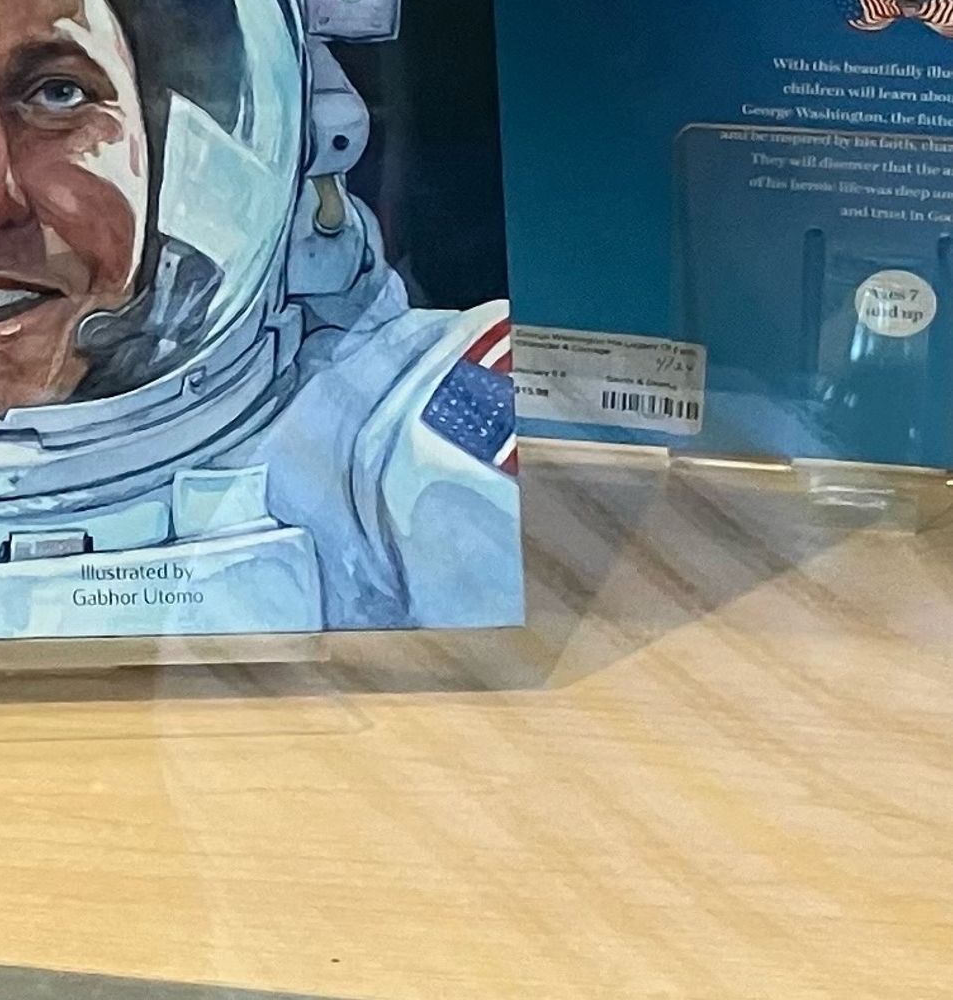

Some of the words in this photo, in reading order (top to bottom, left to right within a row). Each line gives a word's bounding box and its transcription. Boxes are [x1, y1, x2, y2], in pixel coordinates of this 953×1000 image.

[773, 57, 810, 72] With
[812, 59, 841, 73] this
[843, 61, 924, 80] beautifully
[783, 82, 846, 97] children
[848, 85, 876, 99] will
[878, 87, 918, 102] learn
[741, 103, 793, 121] George
[890, 111, 915, 125] the
[751, 152, 786, 169] They
[882, 160, 912, 174] that
[914, 162, 940, 176] the
[864, 185, 893, 196] was
[894, 185, 931, 201] deep
[840, 206, 868, 219] and
[909, 289, 919, 302] 7
[81, 562, 168, 581] Illustrated
[172, 562, 194, 583] by
[72, 587, 138, 606] Gabhor
[143, 586, 204, 605] Utomo
